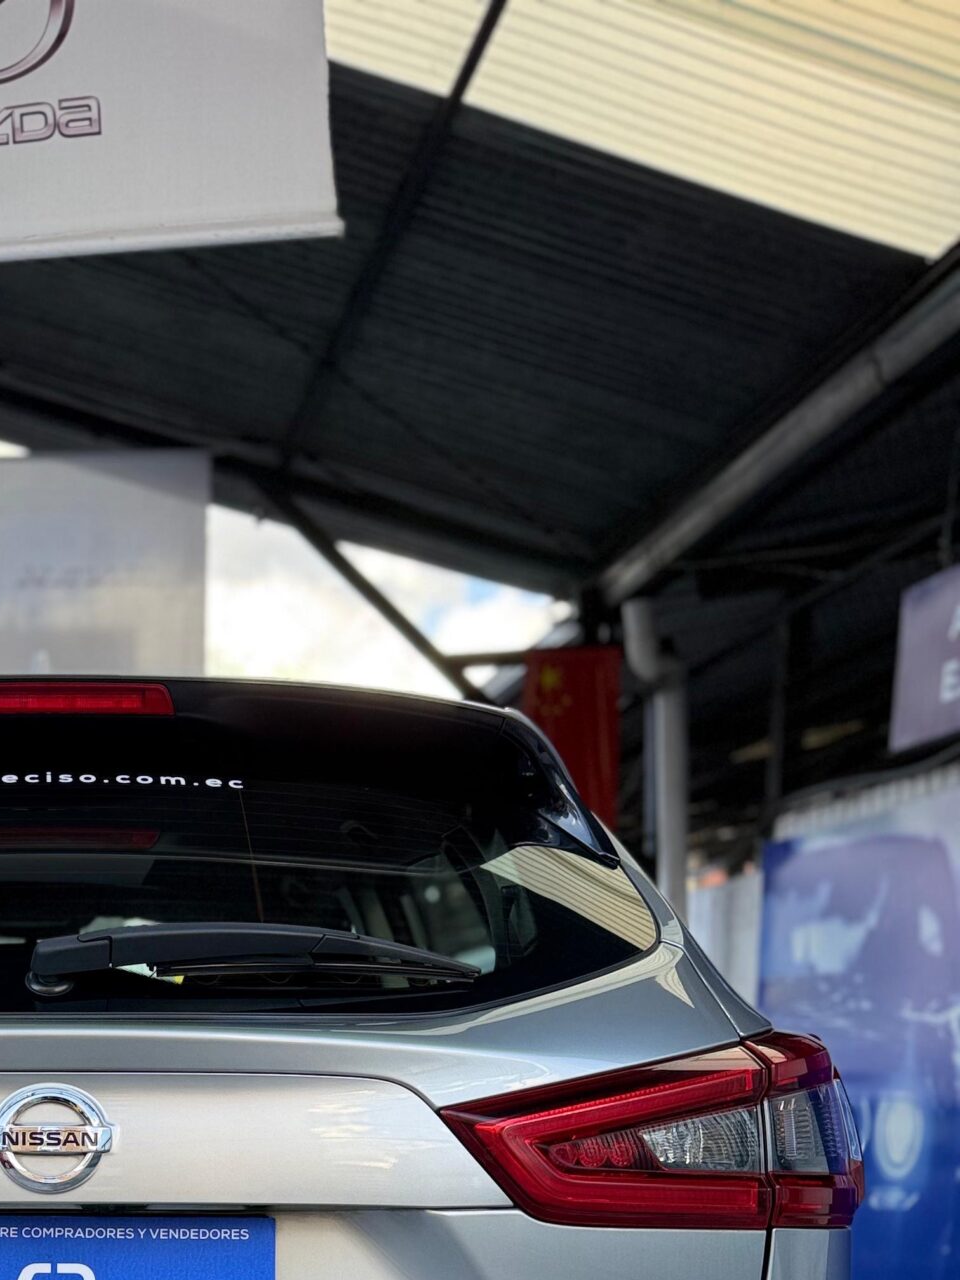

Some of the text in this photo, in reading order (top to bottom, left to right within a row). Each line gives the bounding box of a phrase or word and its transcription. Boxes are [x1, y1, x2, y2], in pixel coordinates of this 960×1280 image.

[1, 1130, 99, 1147] NISSAN
[21, 1226, 135, 1240] COMPRADORES
[137, 1228, 147, 1239] Y
[149, 1227, 250, 1241] VENDEDORES
